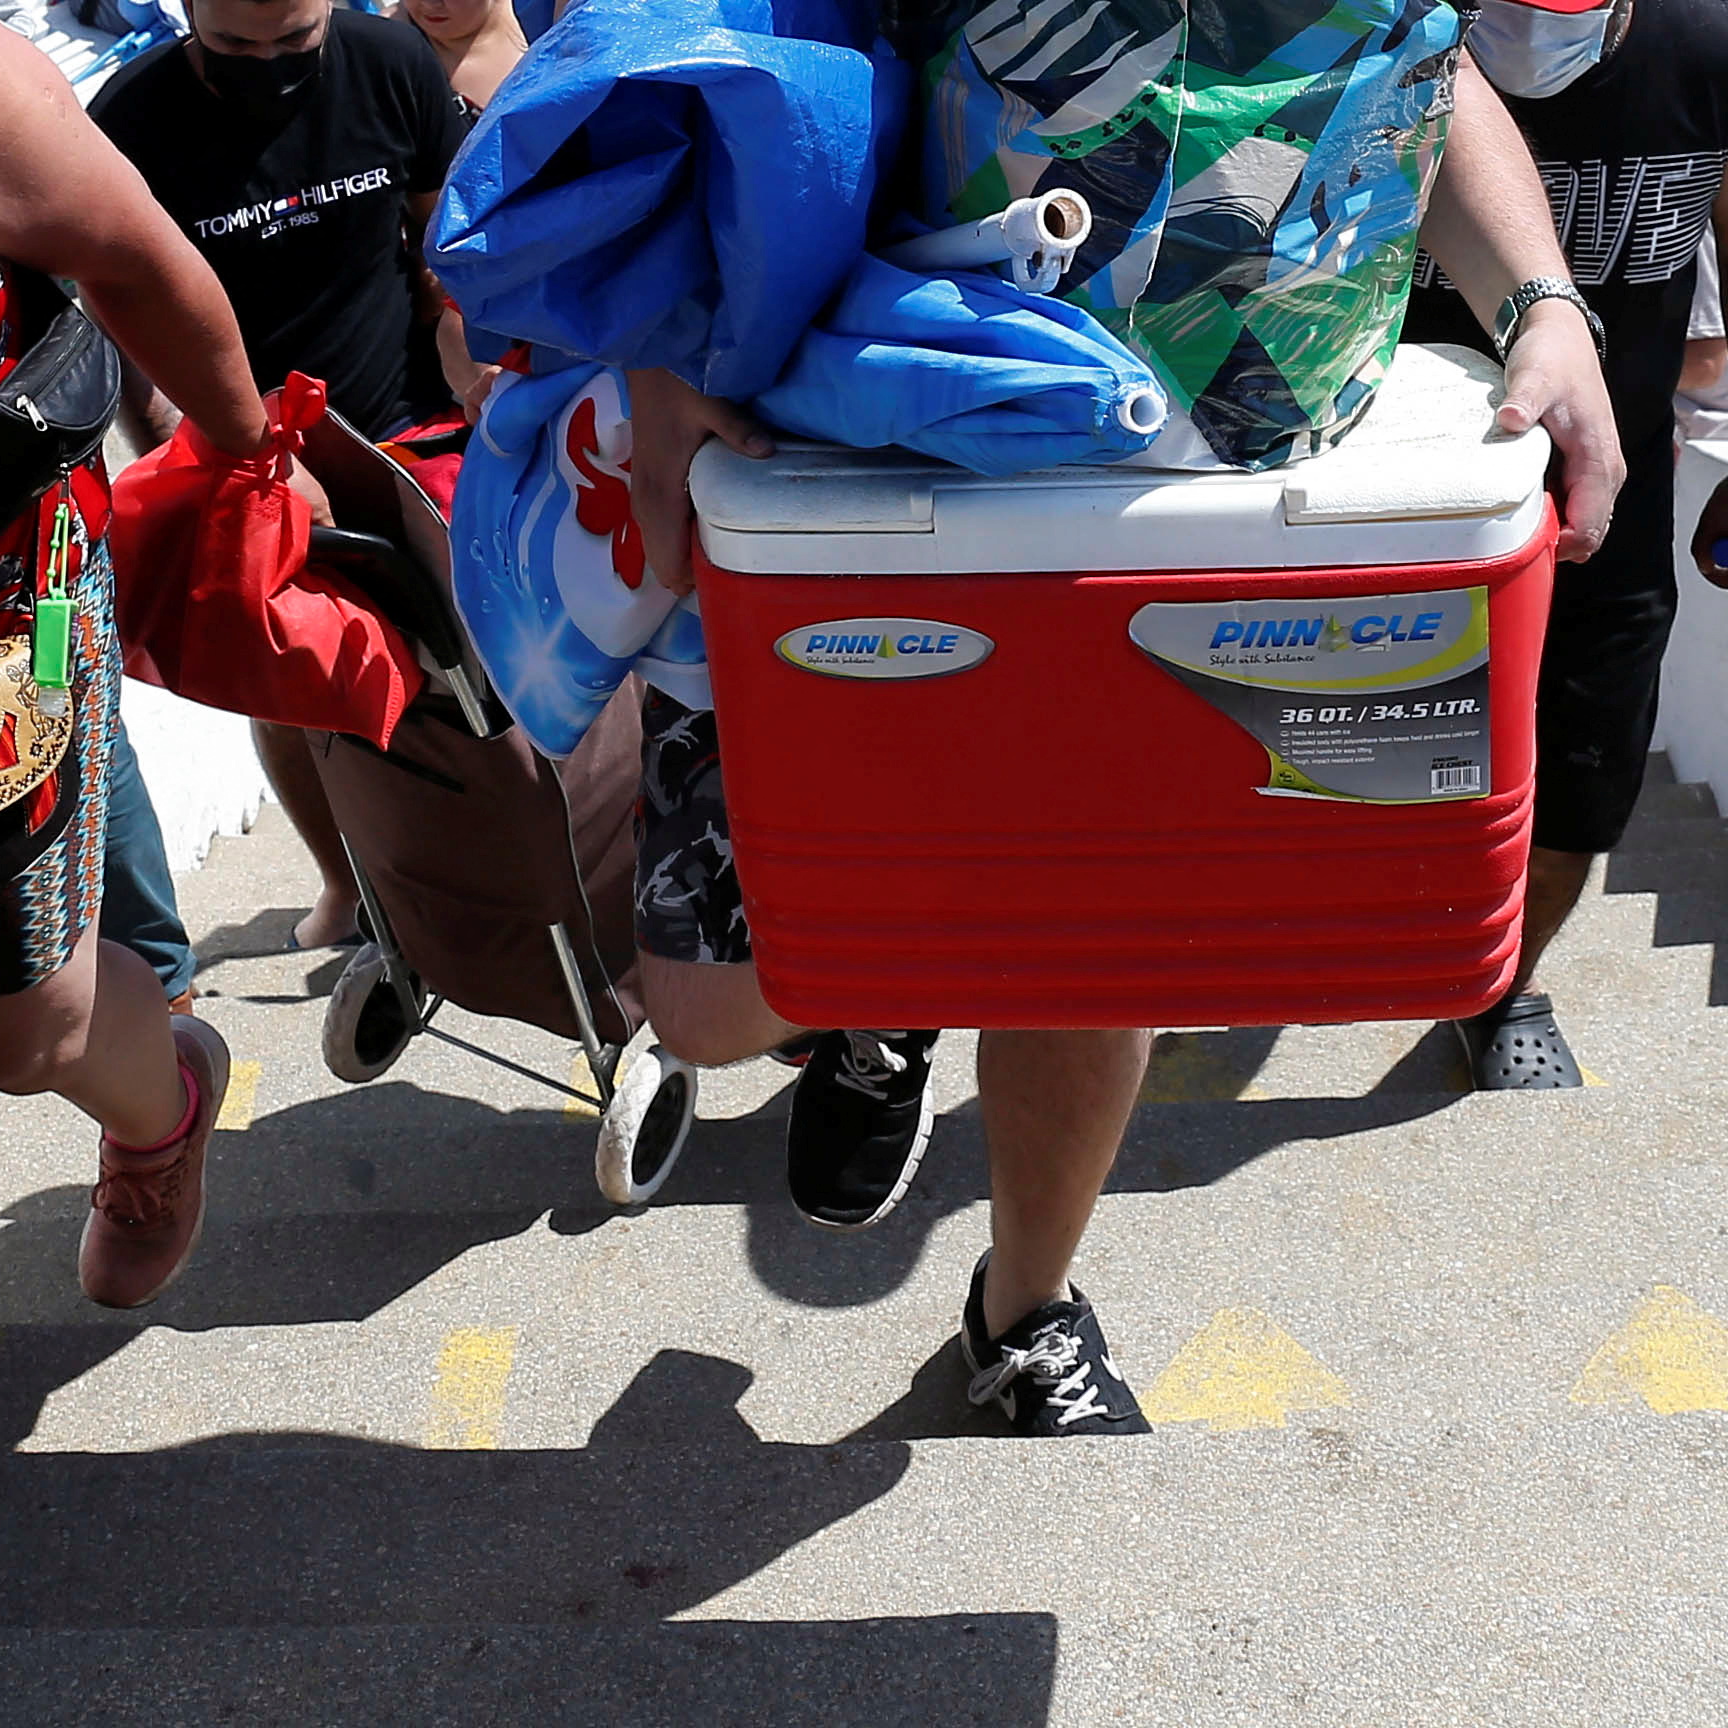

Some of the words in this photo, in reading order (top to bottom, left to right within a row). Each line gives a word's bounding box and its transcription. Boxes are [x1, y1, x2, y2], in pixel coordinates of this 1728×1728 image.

[195, 199, 272, 238] TOMMY
[300, 167, 391, 206] HILFIGER
[261, 221, 287, 239] EST.
[289, 210, 321, 228] 1985
[1209, 653, 1236, 666] Style
[1238, 653, 1262, 664] with
[1263, 652, 1316, 665] Substance
[1279, 708, 1312, 724] 36
[1318, 706, 1354, 724] QT.
[1370, 702, 1430, 721] 34.5
[1432, 698, 1481, 717] LTR.
